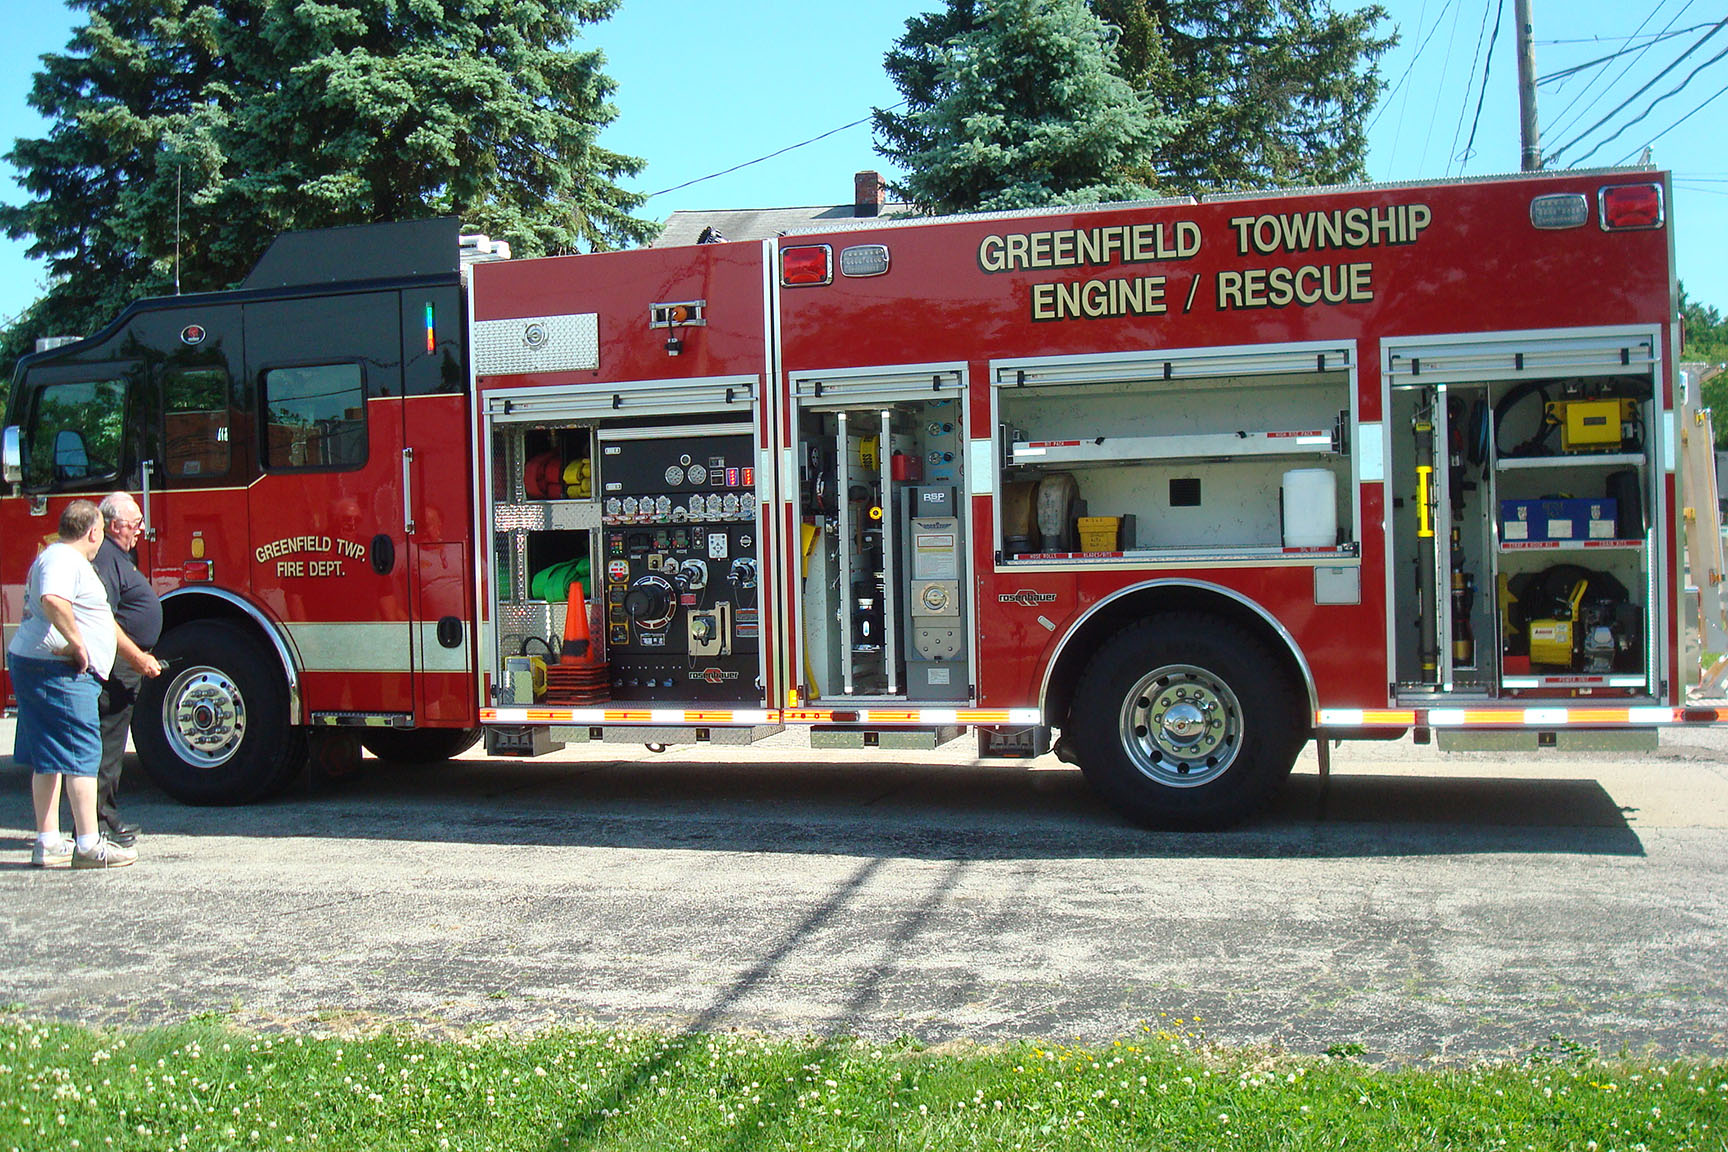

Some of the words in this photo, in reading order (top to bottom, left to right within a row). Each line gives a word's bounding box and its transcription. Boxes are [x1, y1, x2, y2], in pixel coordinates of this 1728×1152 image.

[979, 221, 1202, 273] GREENFIELD
[1230, 204, 1432, 255] TOWNSHIP
[1032, 275, 1168, 322] ENGINE
[1184, 274, 1201, 313] /
[1218, 262, 1374, 310] RESCUE
[255, 535, 332, 563] GREENFIELD
[336, 538, 366, 563] TWP.
[277, 561, 305, 577] FIRE
[309, 560, 346, 577] DEPT.
[998, 591, 1057, 604] rosenbauer
[689, 669, 739, 681] rosenbauer
